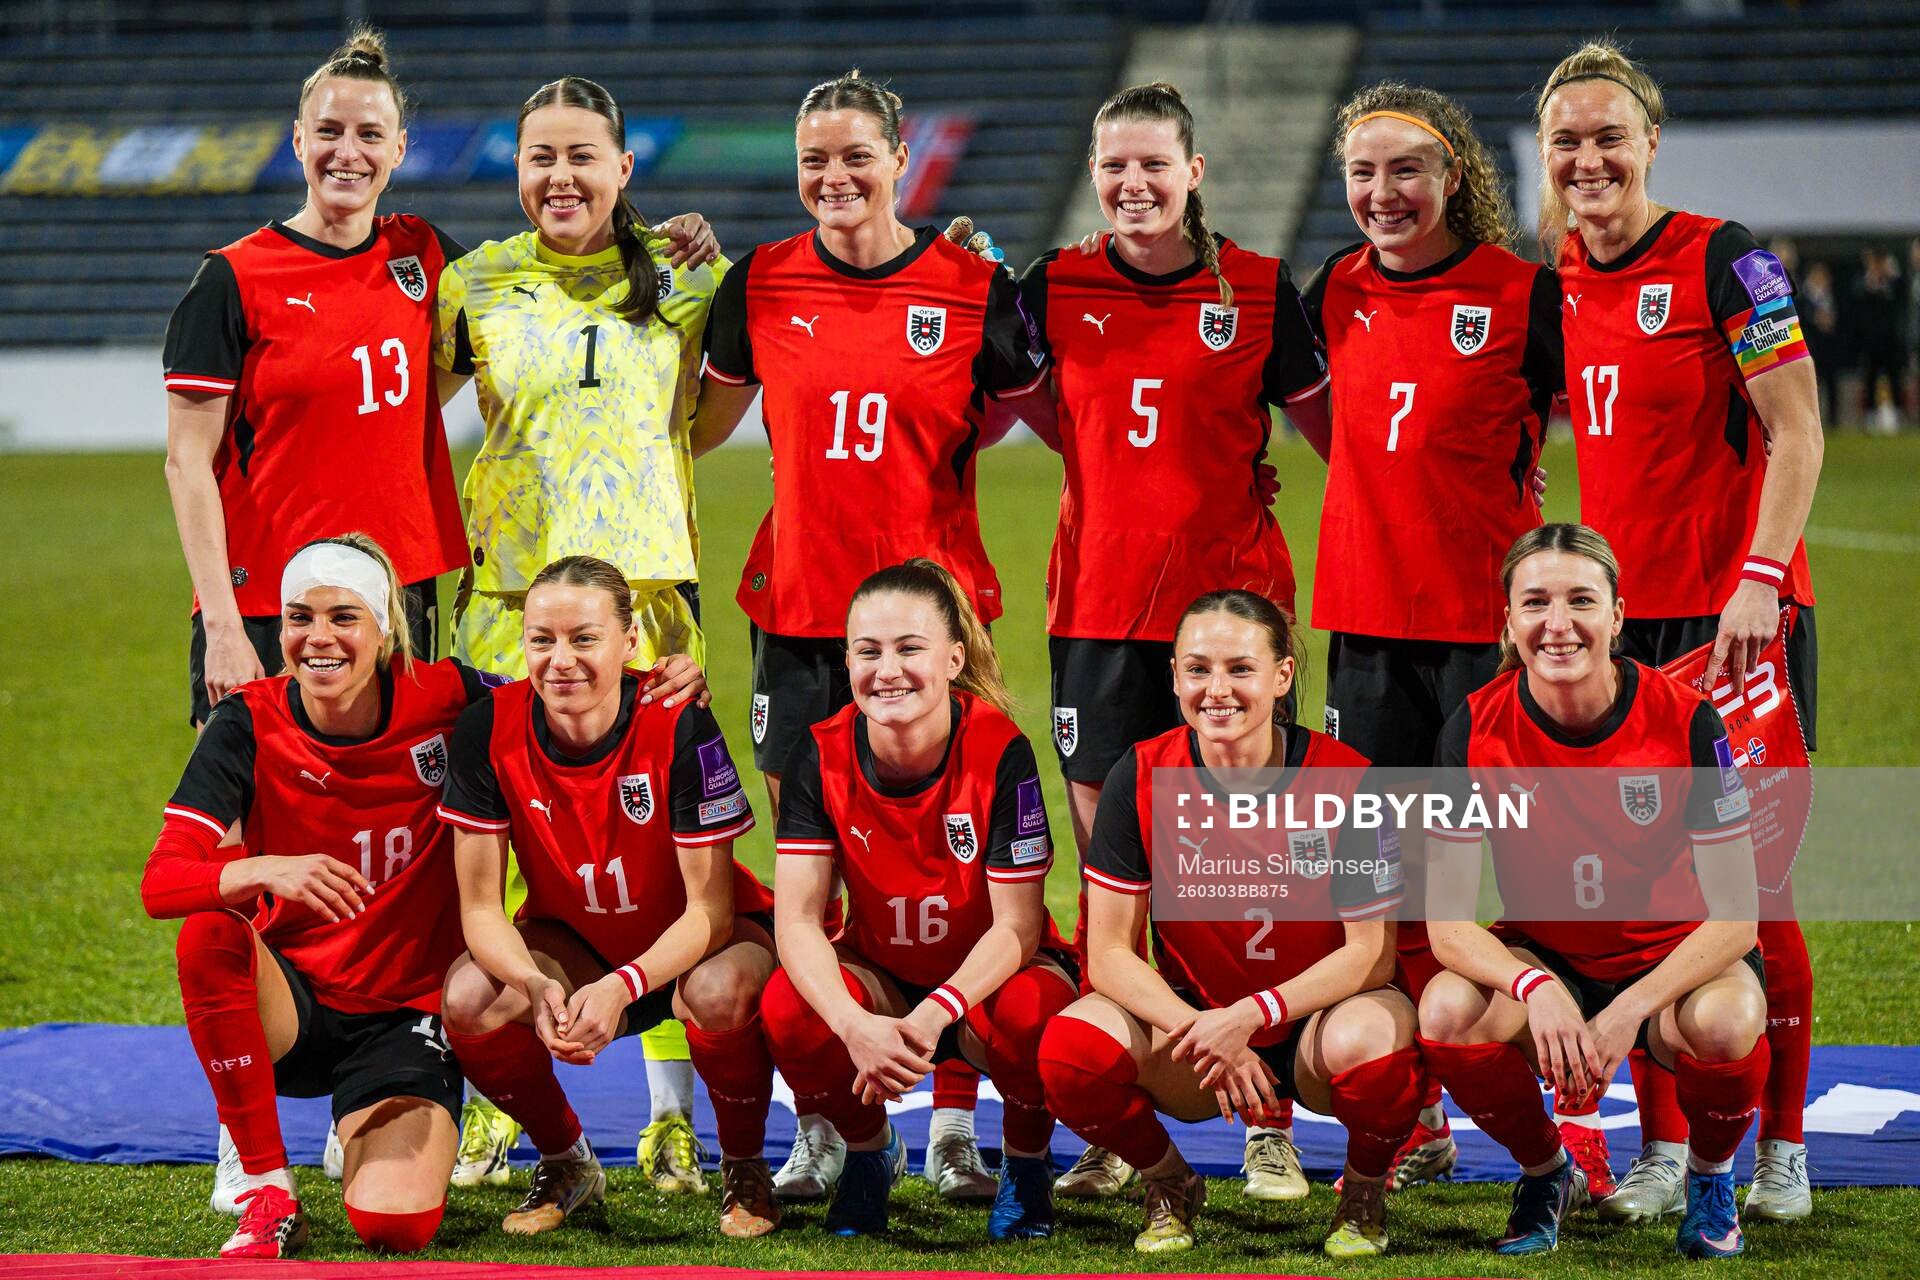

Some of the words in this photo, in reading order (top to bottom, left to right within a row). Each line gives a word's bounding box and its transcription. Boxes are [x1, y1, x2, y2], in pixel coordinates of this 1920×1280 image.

[578, 324, 601, 388] 1
[1743, 326, 1757, 341] BE
[1755, 319, 1774, 336] THE
[1754, 327, 1791, 350] CHANGE
[351, 337, 410, 415] 13
[1581, 365, 1620, 436] 17
[825, 390, 889, 462] 19
[1128, 378, 1164, 448] 5
[1387, 382, 1418, 452] 7
[1729, 714, 1751, 734] 904
[1760, 766, 1789, 791] Norway
[352, 826, 414, 892] 18
[576, 856, 638, 914] 11
[1573, 854, 1605, 910] 8
[886, 895, 949, 946] 16
[1244, 908, 1275, 961] 2
[1767, 1016, 1800, 1027] FB
[210, 1055, 252, 1073] ÖFB
